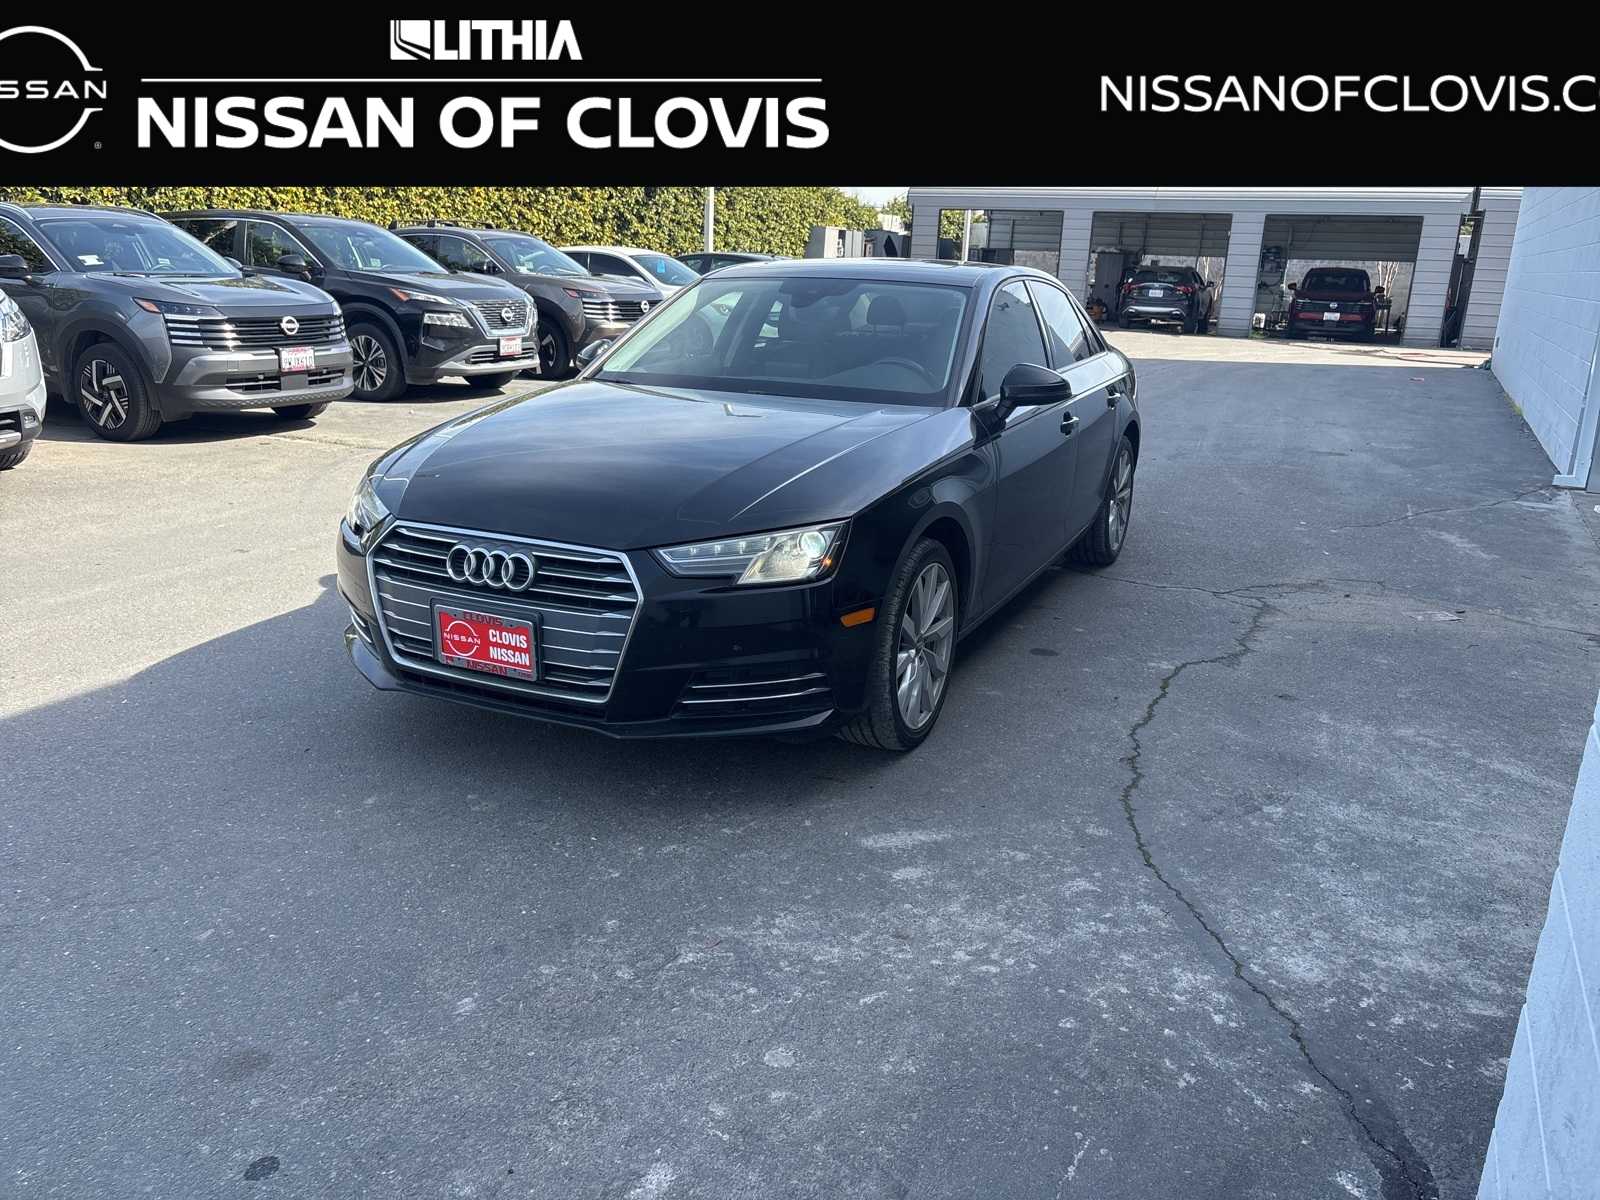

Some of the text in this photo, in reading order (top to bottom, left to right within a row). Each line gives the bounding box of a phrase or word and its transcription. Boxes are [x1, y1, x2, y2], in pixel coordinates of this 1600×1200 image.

[443, 632, 481, 645] NISSAN
[488, 629, 528, 648] CLOVIS
[489, 646, 530, 666] NISSAN
[463, 660, 508, 676] NISSAN
